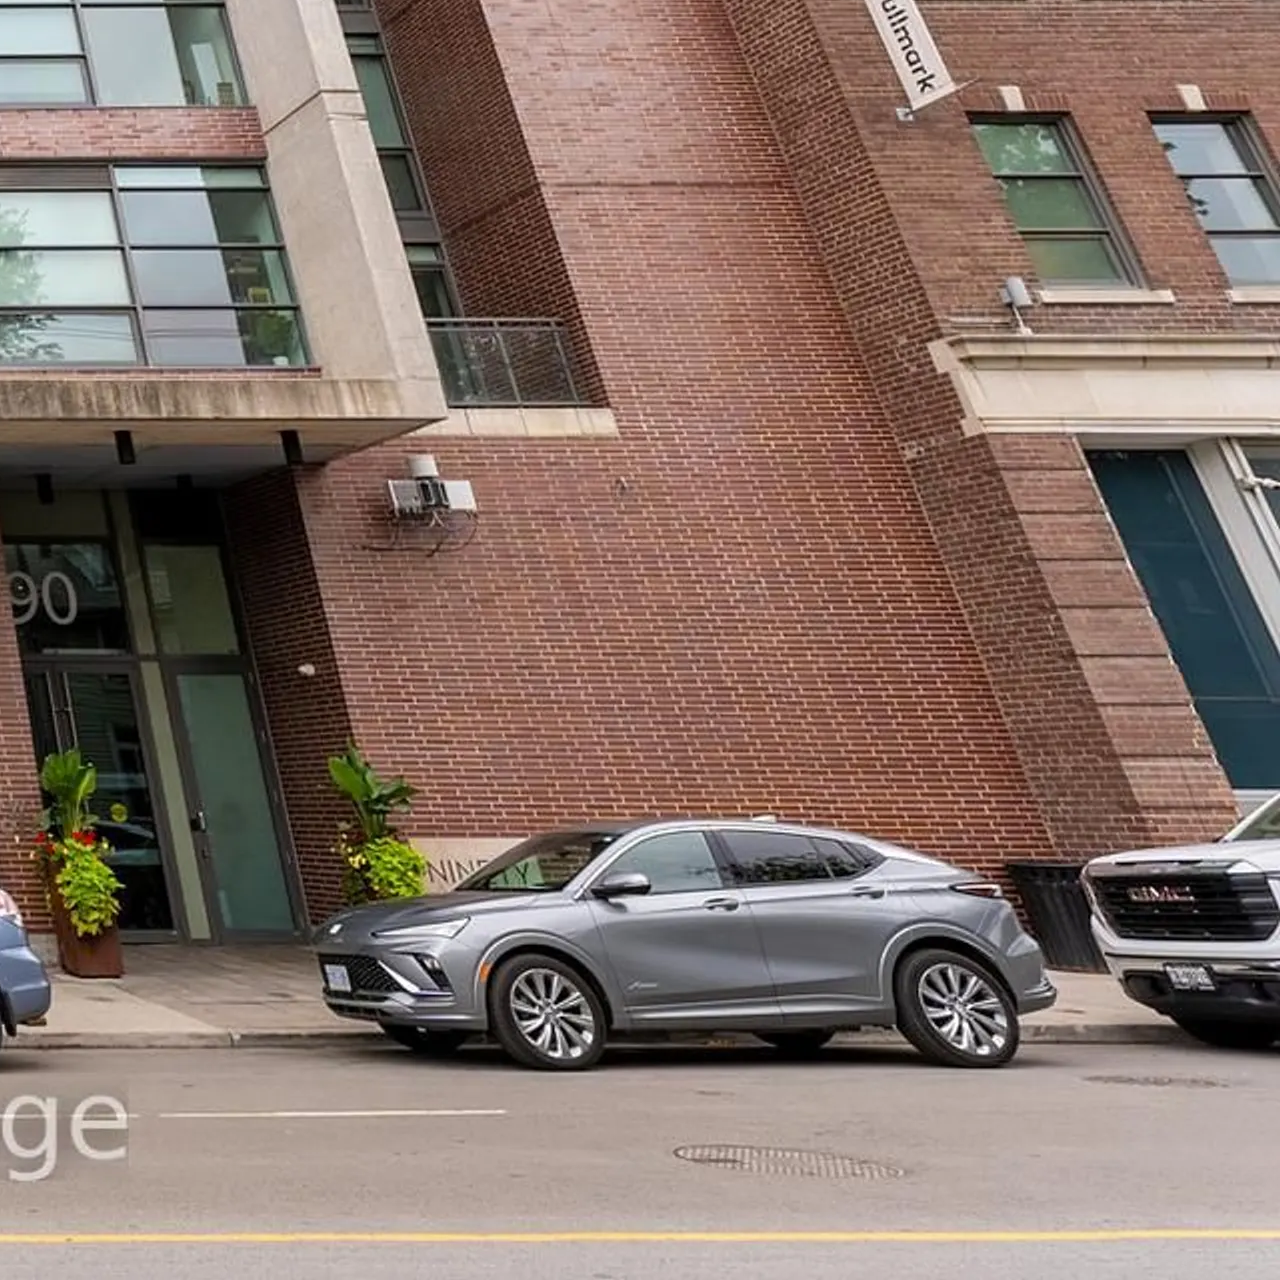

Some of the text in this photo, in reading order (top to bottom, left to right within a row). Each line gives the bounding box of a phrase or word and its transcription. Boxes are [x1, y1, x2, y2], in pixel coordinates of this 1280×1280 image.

[4, 568, 78, 625] 90
[426, 860, 529, 885] NINY
[1127, 885, 1195, 902] GMC
